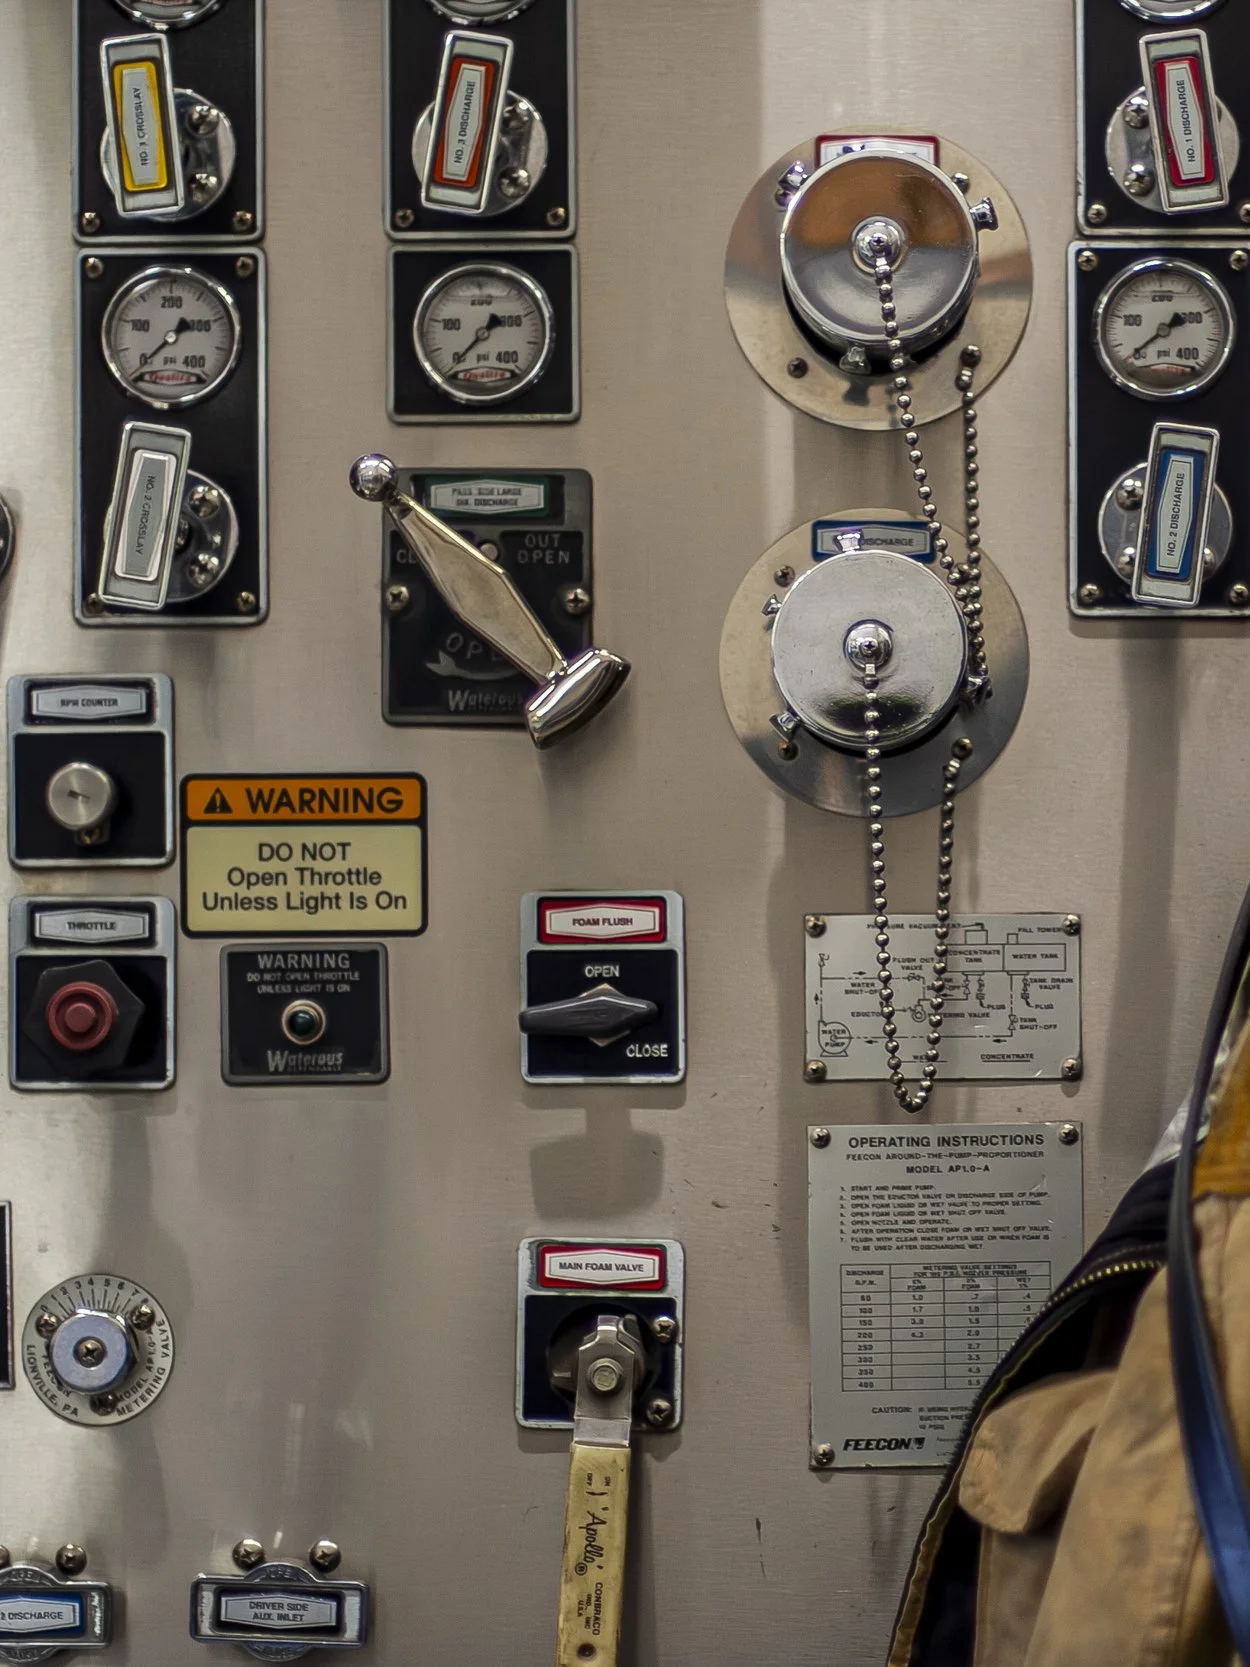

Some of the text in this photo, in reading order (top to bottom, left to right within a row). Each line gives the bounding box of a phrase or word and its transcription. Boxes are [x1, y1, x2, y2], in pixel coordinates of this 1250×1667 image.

[132, 88, 147, 139] CROSSLAY
[459, 80, 476, 138] DISCHARGE
[1176, 80, 1193, 136] DISCHARGE
[1188, 145, 1196, 163] NO.
[161, 296, 183, 309] 200
[131, 319, 150, 332] 100
[442, 319, 461, 331] 100
[1123, 314, 1142, 326] 100
[477, 352, 489, 364] psi
[496, 351, 518, 364] 400
[1157, 347, 1199, 360] psi 400
[163, 356, 177, 366] psi
[182, 355, 206, 368] 400
[474, 499, 519, 507] DISCHARGE
[1171, 472, 1185, 530] DISCHARGE
[136, 503, 151, 556] CROSSLAY
[525, 534, 561, 548] OUT
[1167, 538, 1176, 556] NO.
[517, 550, 570, 565] OPEN
[81, 698, 118, 707] COUNTER
[245, 786, 404, 814] WARNING
[258, 842, 351, 862] DO NOT
[227, 867, 382, 890] Open Throttle
[202, 890, 407, 915] Unless Light Is On
[67, 921, 116, 930] THROTTLE
[572, 917, 634, 926] FOAM FLUSH
[257, 953, 351, 969] WARNING
[247, 971, 360, 982] DO NOT OPEN THROTTLE
[584, 964, 620, 979] OPEN
[257, 984, 351, 994] UNLESS LIGHT IS ON
[626, 1043, 669, 1058] CLOSE
[267, 1050, 344, 1072] Waterous
[848, 1134, 1045, 1149] OPERATING INSTRUCTIONS
[846, 1153, 881, 1161] FEECON
[906, 1164, 990, 1174] MODEL AP1.0-A
[559, 1262, 644, 1272] MAIN FOAM VALVE
[75, 1281, 82, 1290] 3
[88, 1277, 94, 1286] 4
[104, 1278, 111, 1287] 5
[60, 1286, 69, 1296] 2
[116, 1318, 170, 1416] METERING VALVE
[62, 1403, 79, 1417] PA
[843, 1438, 912, 1451] FEECON
[604, 1476, 612, 1487] ON
[249, 1601, 309, 1612] DRIVER SIDE
[592, 1582, 604, 1636] CONBRACO
[8, 1611, 64, 1620] DISCHARGE
[252, 1613, 305, 1622] AUX. INLET
